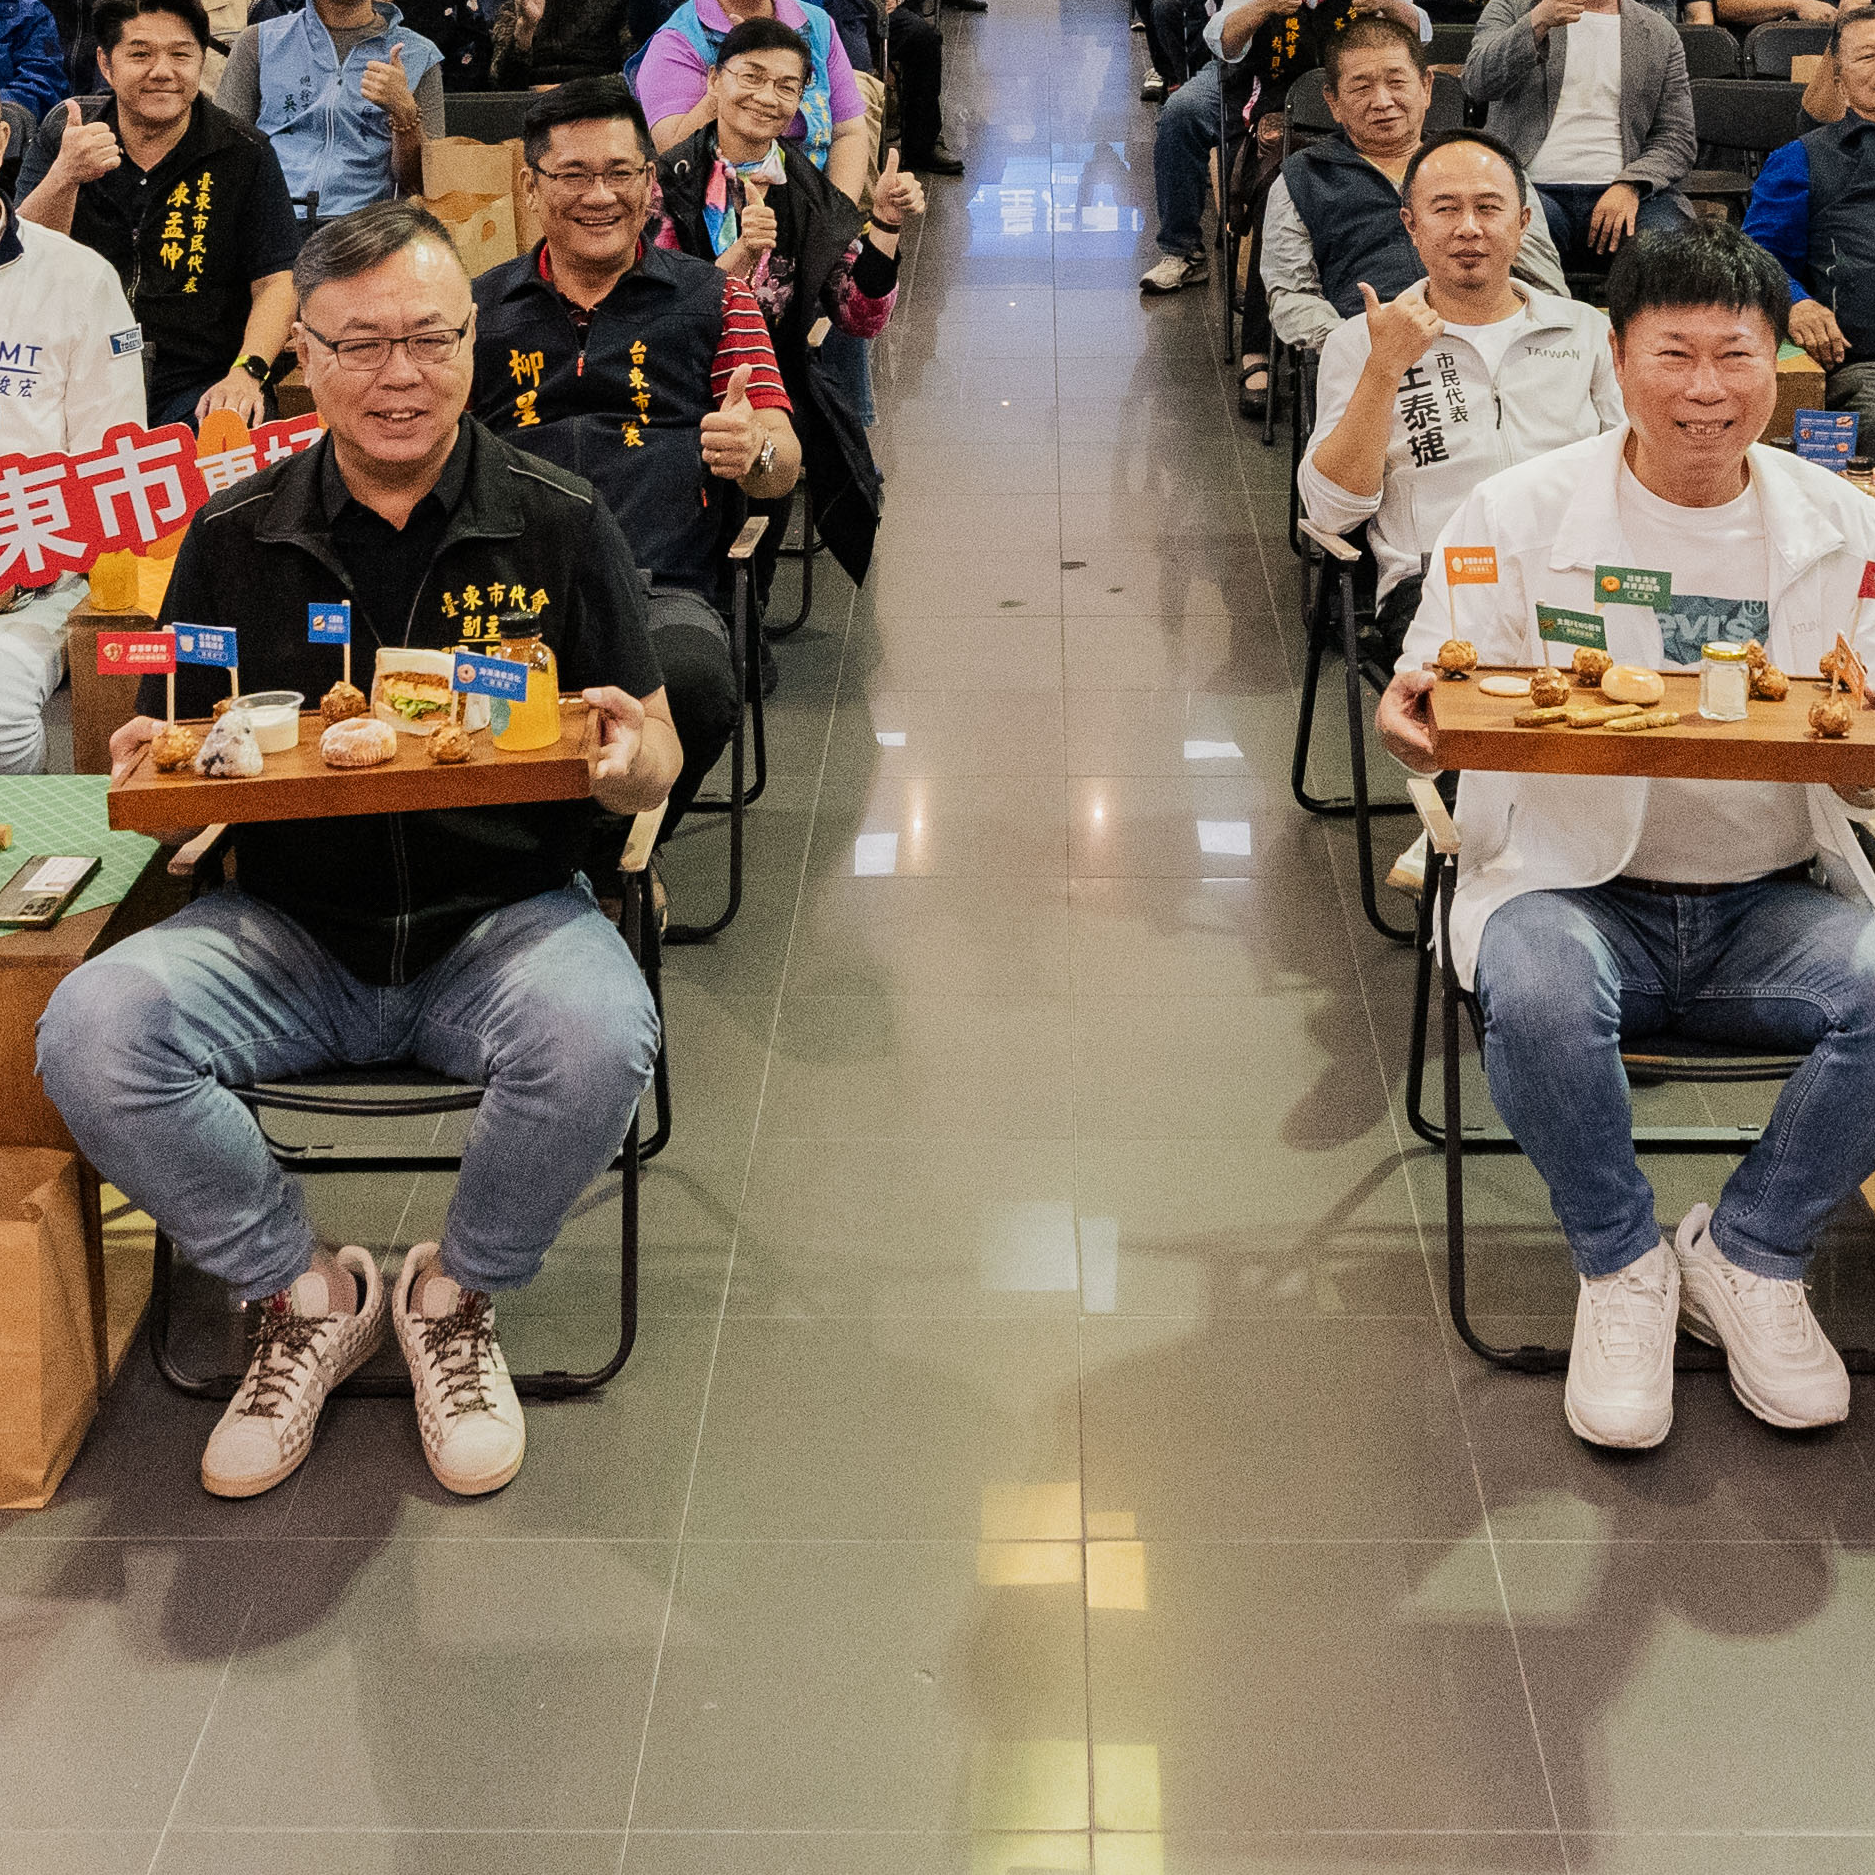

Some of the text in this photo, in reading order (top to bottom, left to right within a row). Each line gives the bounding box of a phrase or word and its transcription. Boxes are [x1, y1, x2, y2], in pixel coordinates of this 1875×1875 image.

[159, 171, 215, 294] 陳孟伸 臺東市民代表
[1524, 345, 1581, 361] TAIWAN
[1433, 351, 1470, 425] 市民代表
[441, 581, 552, 619] 臺東市代會
